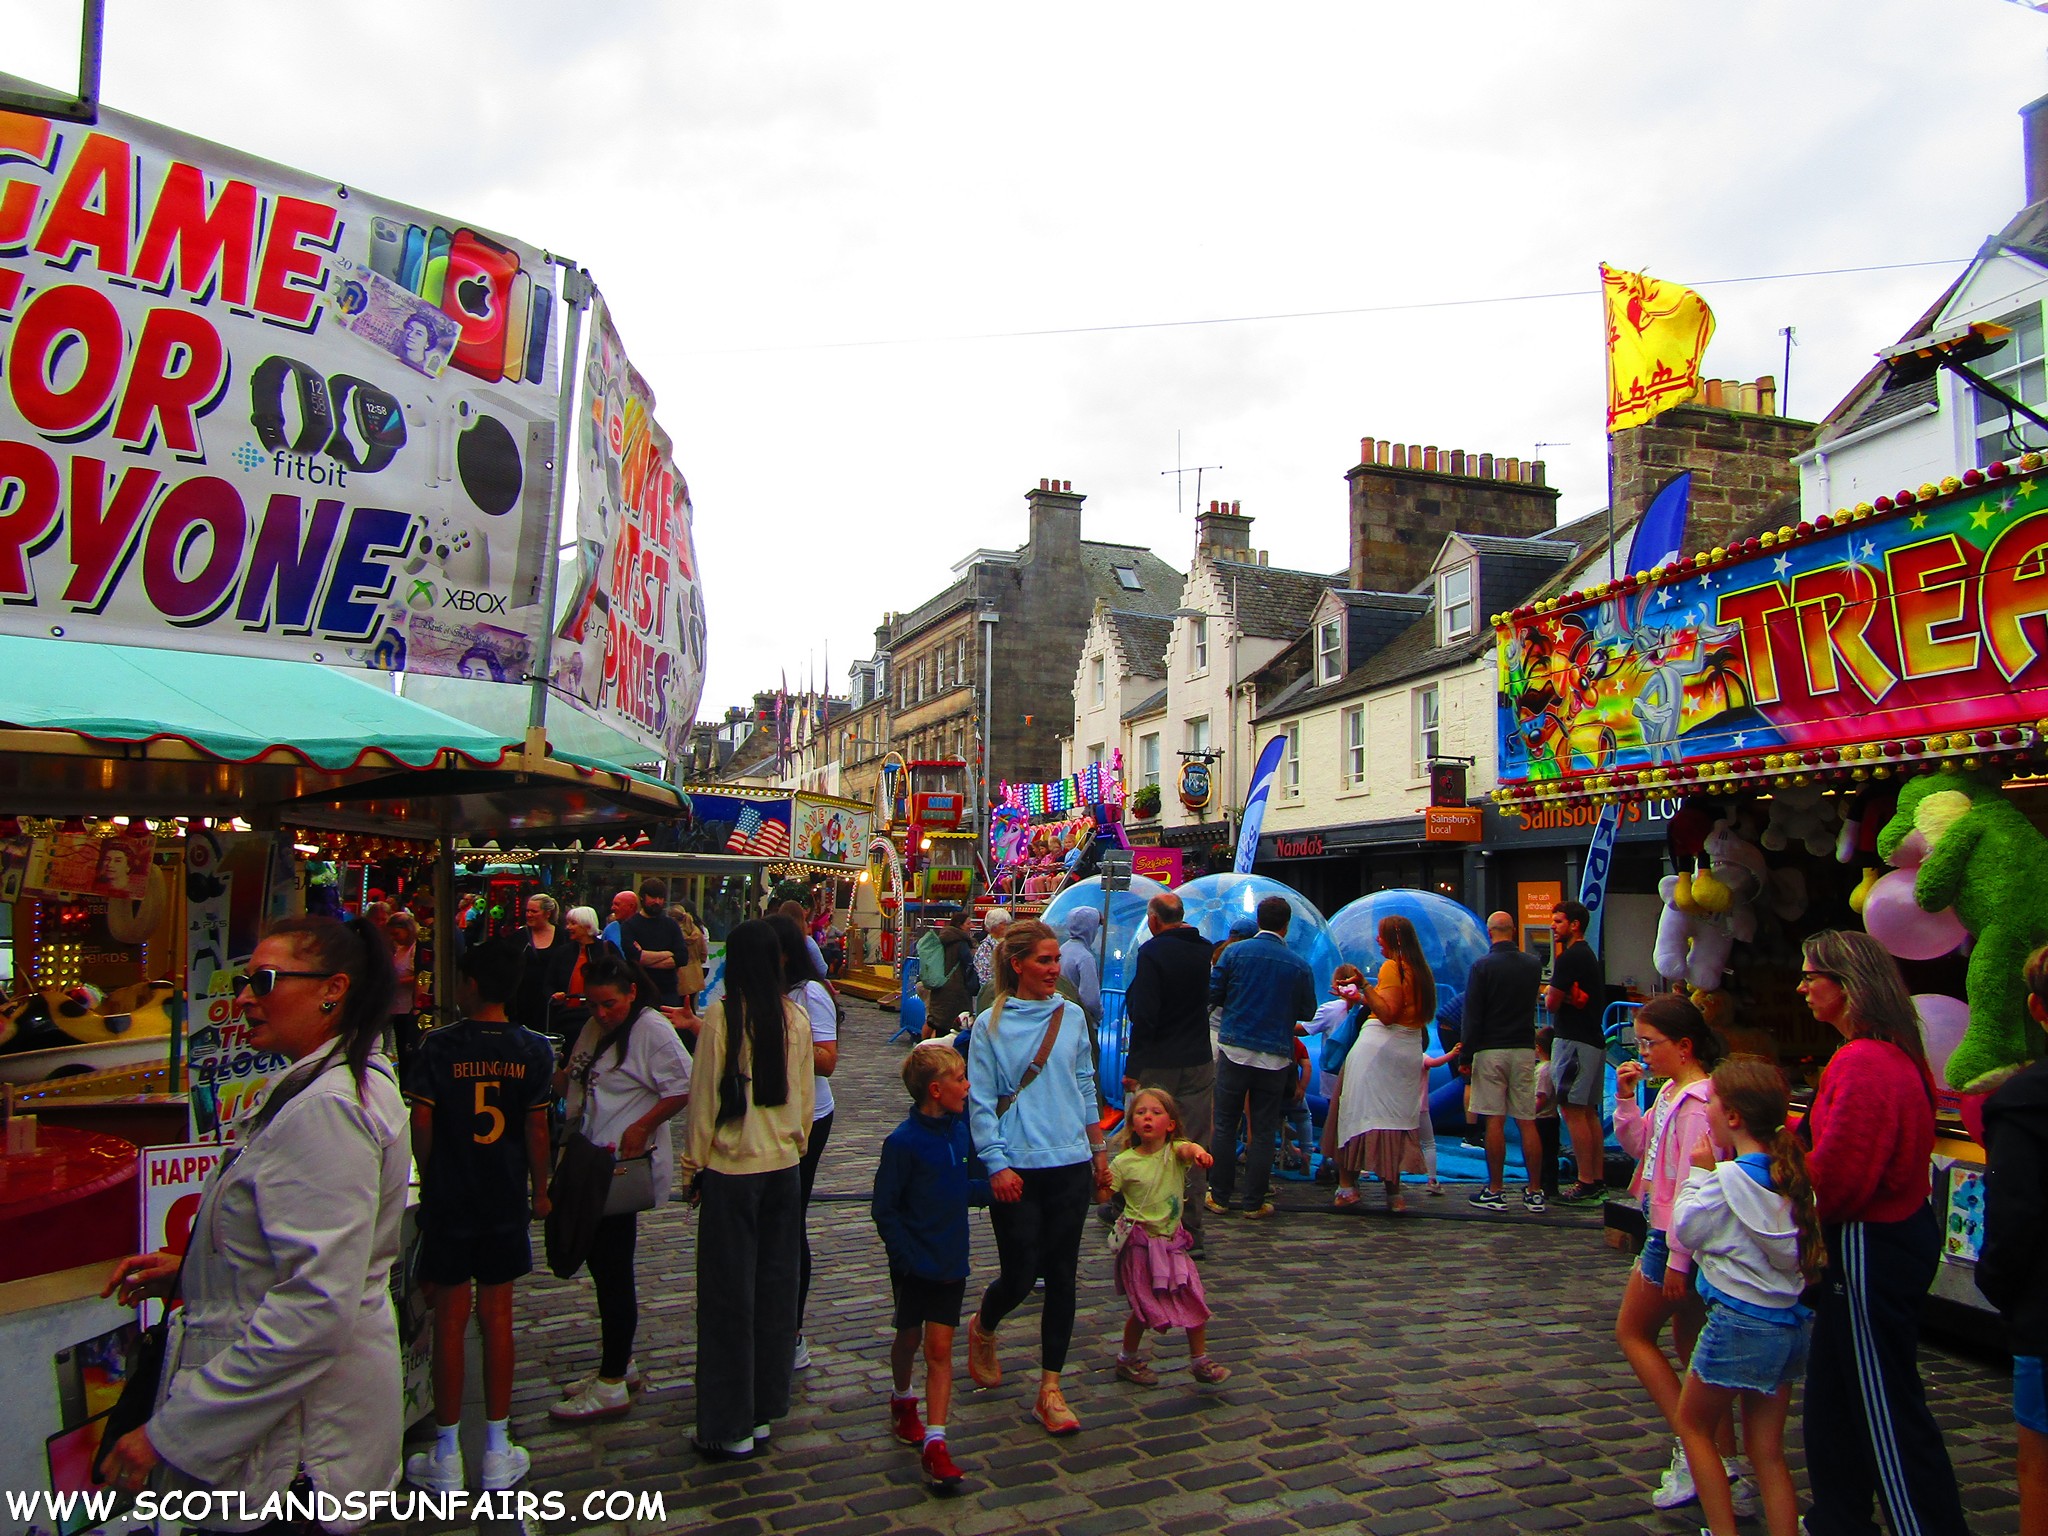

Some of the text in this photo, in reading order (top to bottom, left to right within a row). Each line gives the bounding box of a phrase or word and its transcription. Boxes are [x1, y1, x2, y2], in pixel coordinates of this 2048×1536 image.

[0, 268, 230, 465] OR
[273, 450, 349, 489] fitbit
[442, 587, 508, 616] XBOX
[928, 796, 954, 809] MINI
[1430, 814, 1476, 826] Sainsbury's
[1430, 825, 1452, 834] Local
[797, 807, 862, 858] HAVE FUN
[1276, 834, 1324, 857] Nando's
[1135, 854, 1174, 872] Super
[937, 870, 963, 881] MINI
[930, 883, 966, 894] WHEEL
[220, 1024, 253, 1052] TH
[453, 1060, 527, 1080] BELLINGHAM
[472, 1081, 507, 1145] 5
